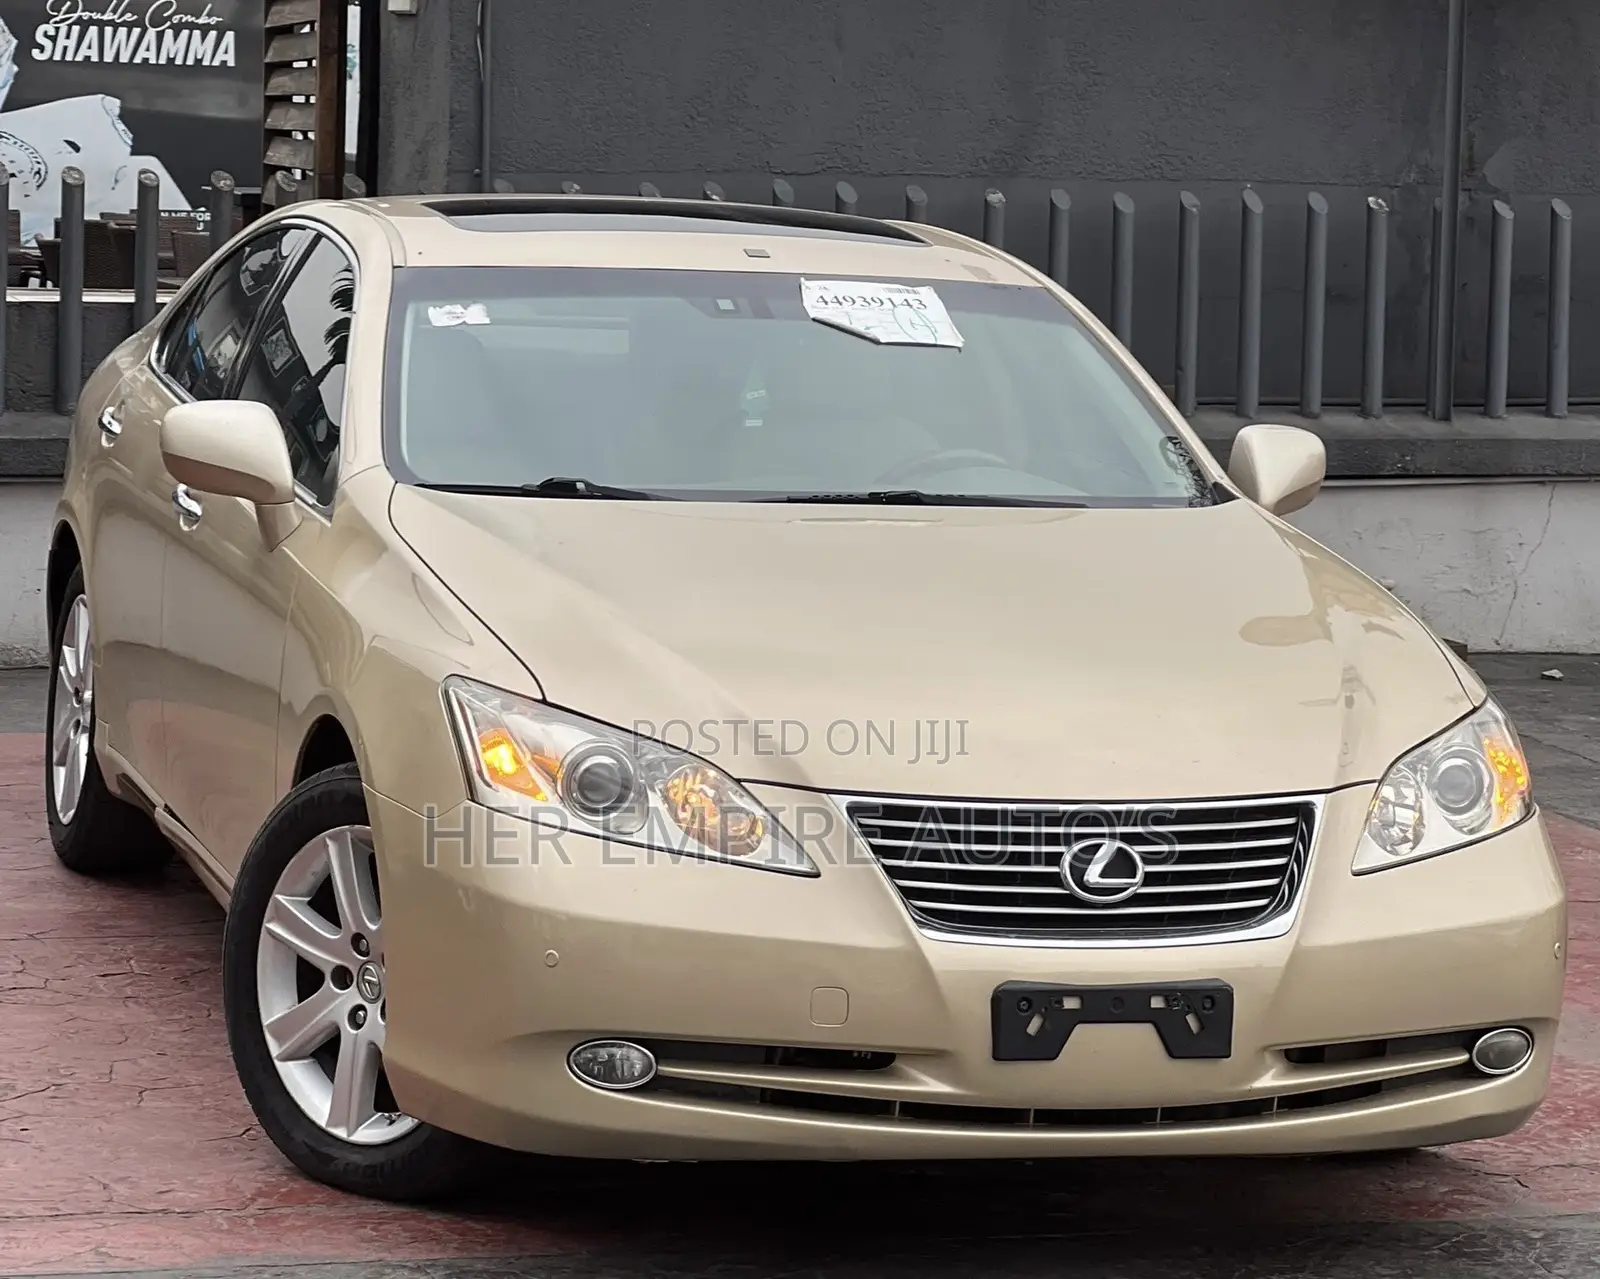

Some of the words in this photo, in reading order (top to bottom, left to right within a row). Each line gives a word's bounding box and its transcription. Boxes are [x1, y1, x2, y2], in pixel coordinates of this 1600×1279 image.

[46, 0, 139, 27] Double
[145, 0, 224, 31] Combo
[31, 23, 236, 67] SHAWAMMA
[816, 294, 927, 311] 44939143
